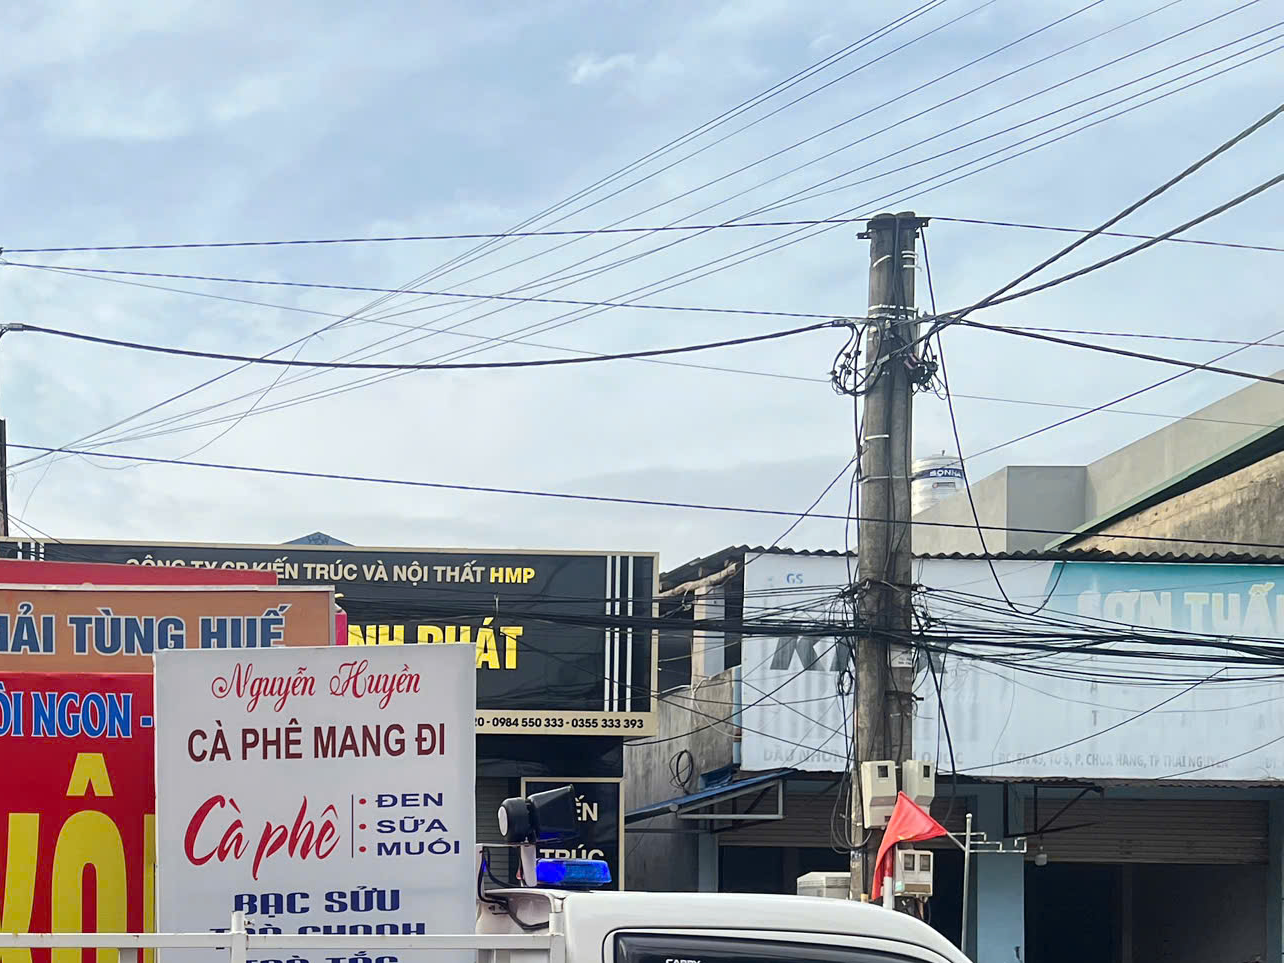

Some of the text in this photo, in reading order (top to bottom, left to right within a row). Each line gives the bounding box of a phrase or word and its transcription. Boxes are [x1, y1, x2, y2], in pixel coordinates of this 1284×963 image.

[303, 559, 358, 582] TRÚC
[362, 559, 389, 582] VÀ
[393, 560, 428, 587] NỘI
[433, 559, 486, 583] THẤT
[489, 566, 536, 584] HMP
[786, 573, 804, 585] GS
[68, 607, 187, 656] TÙNG
[199, 603, 292, 648] HUẾ
[210, 657, 422, 713] Nguyễn Huyền
[31, 691, 133, 739] NGON
[491, 717, 519, 730] 0984
[520, 717, 543, 730] 550
[543, 717, 565, 730] 333
[571, 717, 598, 730] 0355
[600, 718, 621, 730] 333
[623, 718, 645, 730] 393
[188, 718, 447, 762] CÀ PHÊ MANG ĐI
[374, 792, 444, 808] ĐEN
[576, 796, 599, 822] ẾN
[183, 793, 342, 881] Cà phê
[375, 816, 449, 834] SỮA
[234, 892, 310, 918] BẠC
